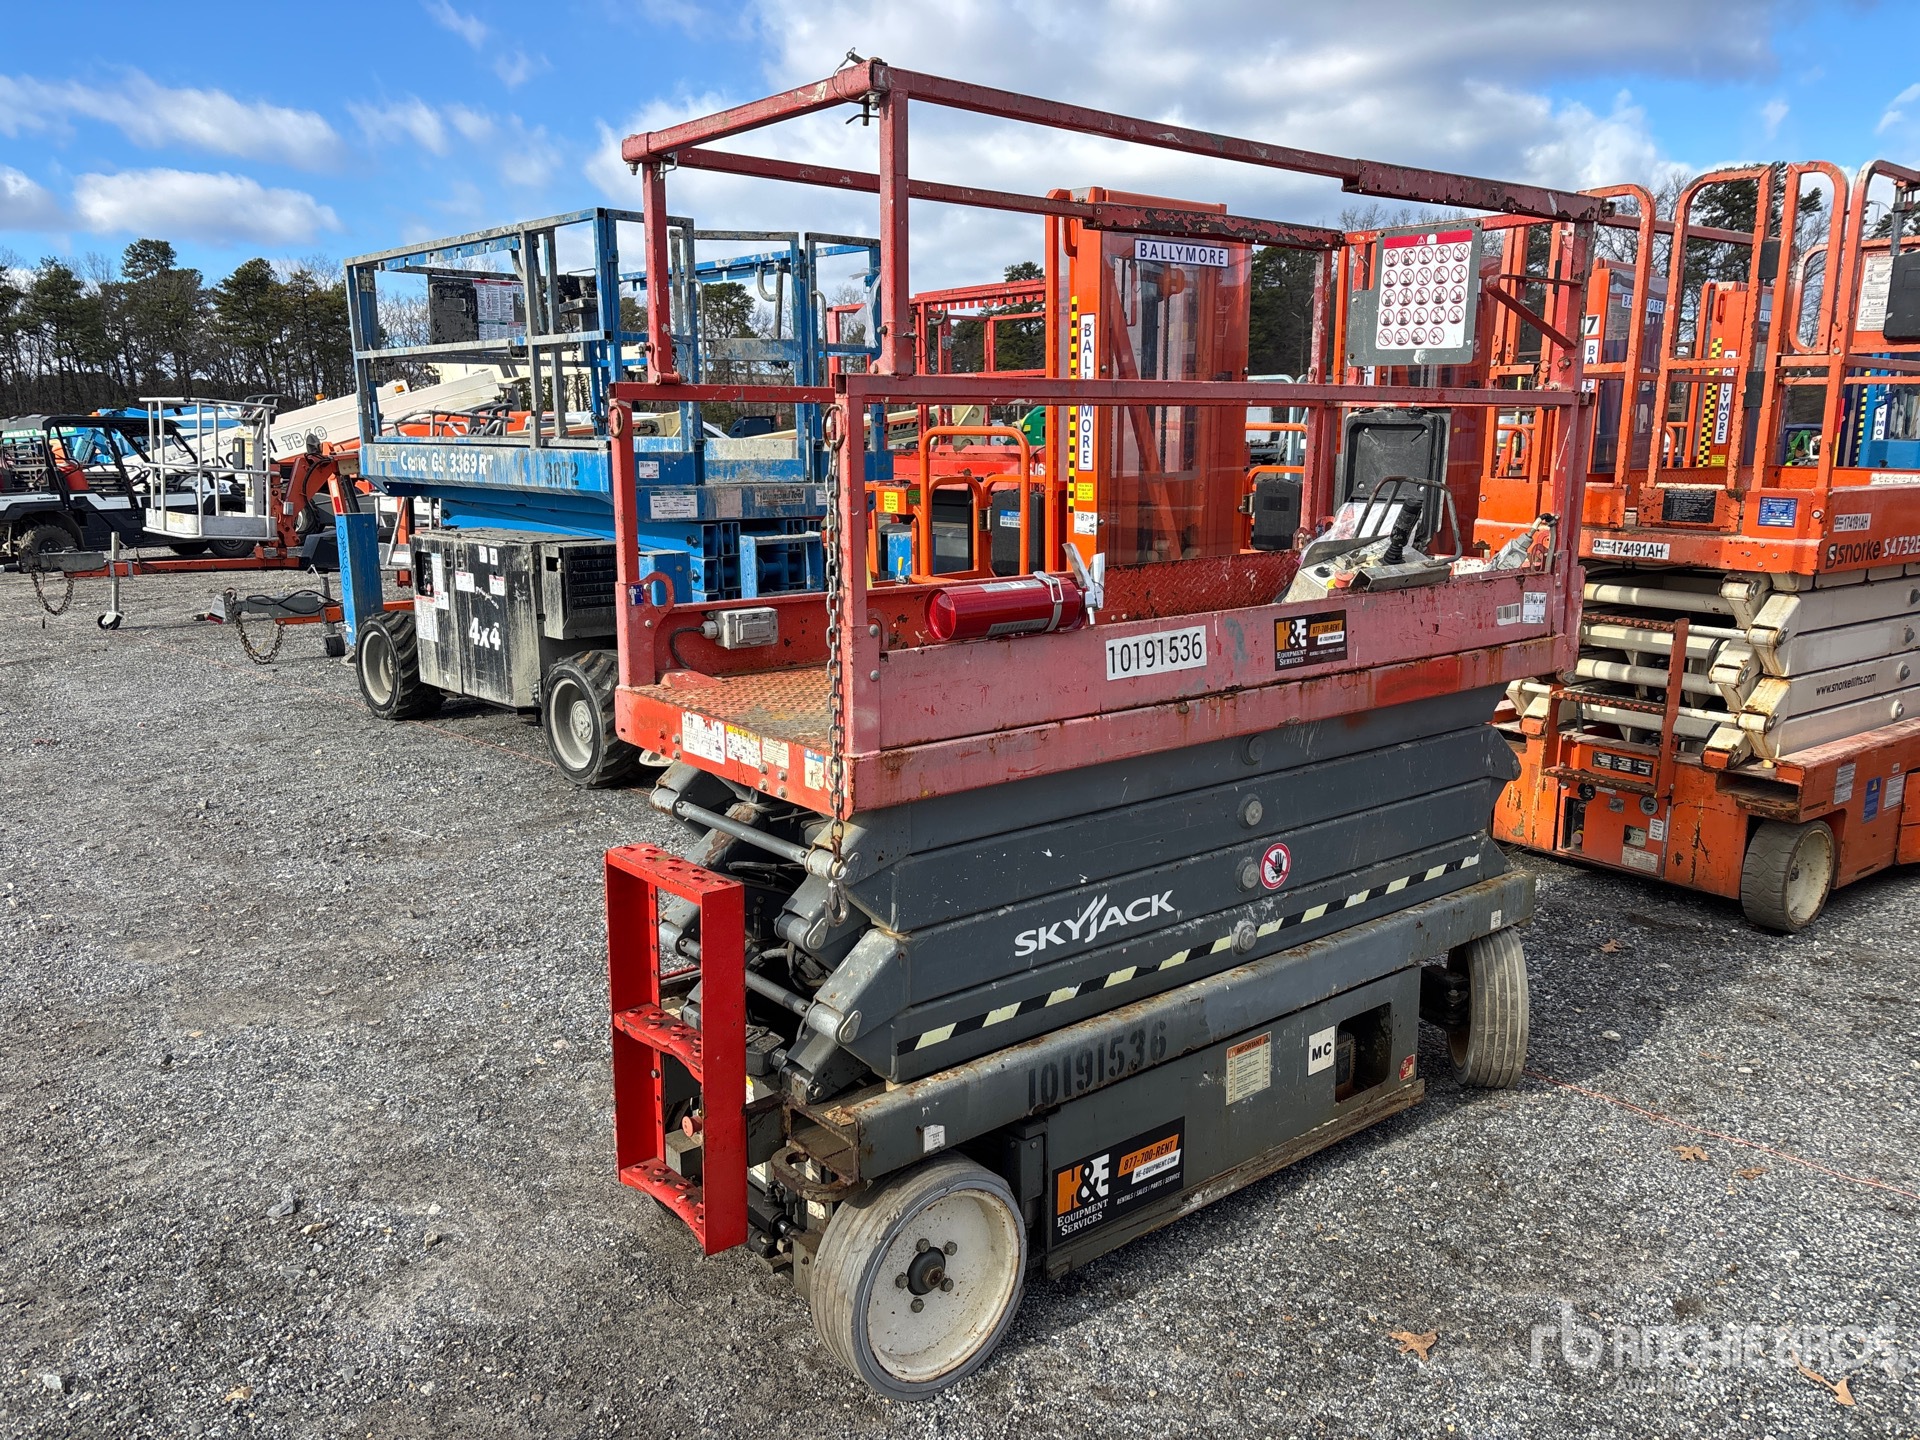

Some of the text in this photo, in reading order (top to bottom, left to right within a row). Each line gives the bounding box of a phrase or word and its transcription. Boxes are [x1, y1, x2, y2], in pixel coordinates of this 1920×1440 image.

[1140, 242, 1224, 265] BALLYMORE
[1080, 323, 1094, 464] BALMORE
[431, 452, 445, 473] GS
[1612, 540, 1664, 558] 174191AH
[469, 616, 501, 651] 4x4
[1276, 618, 1307, 651] H&E
[1108, 632, 1203, 674] 10191536
[1014, 889, 1176, 957] SKYJACK
[1236, 1038, 1263, 1054] IMPORTANT
[1311, 1042, 1332, 1062] MC
[1028, 1021, 1167, 1110] 10191536
[1123, 1140, 1175, 1170] 877-700-RENT
[1135, 1155, 1178, 1179] HE-EQUIPMENT.COM
[1057, 1153, 1110, 1216] H&E
